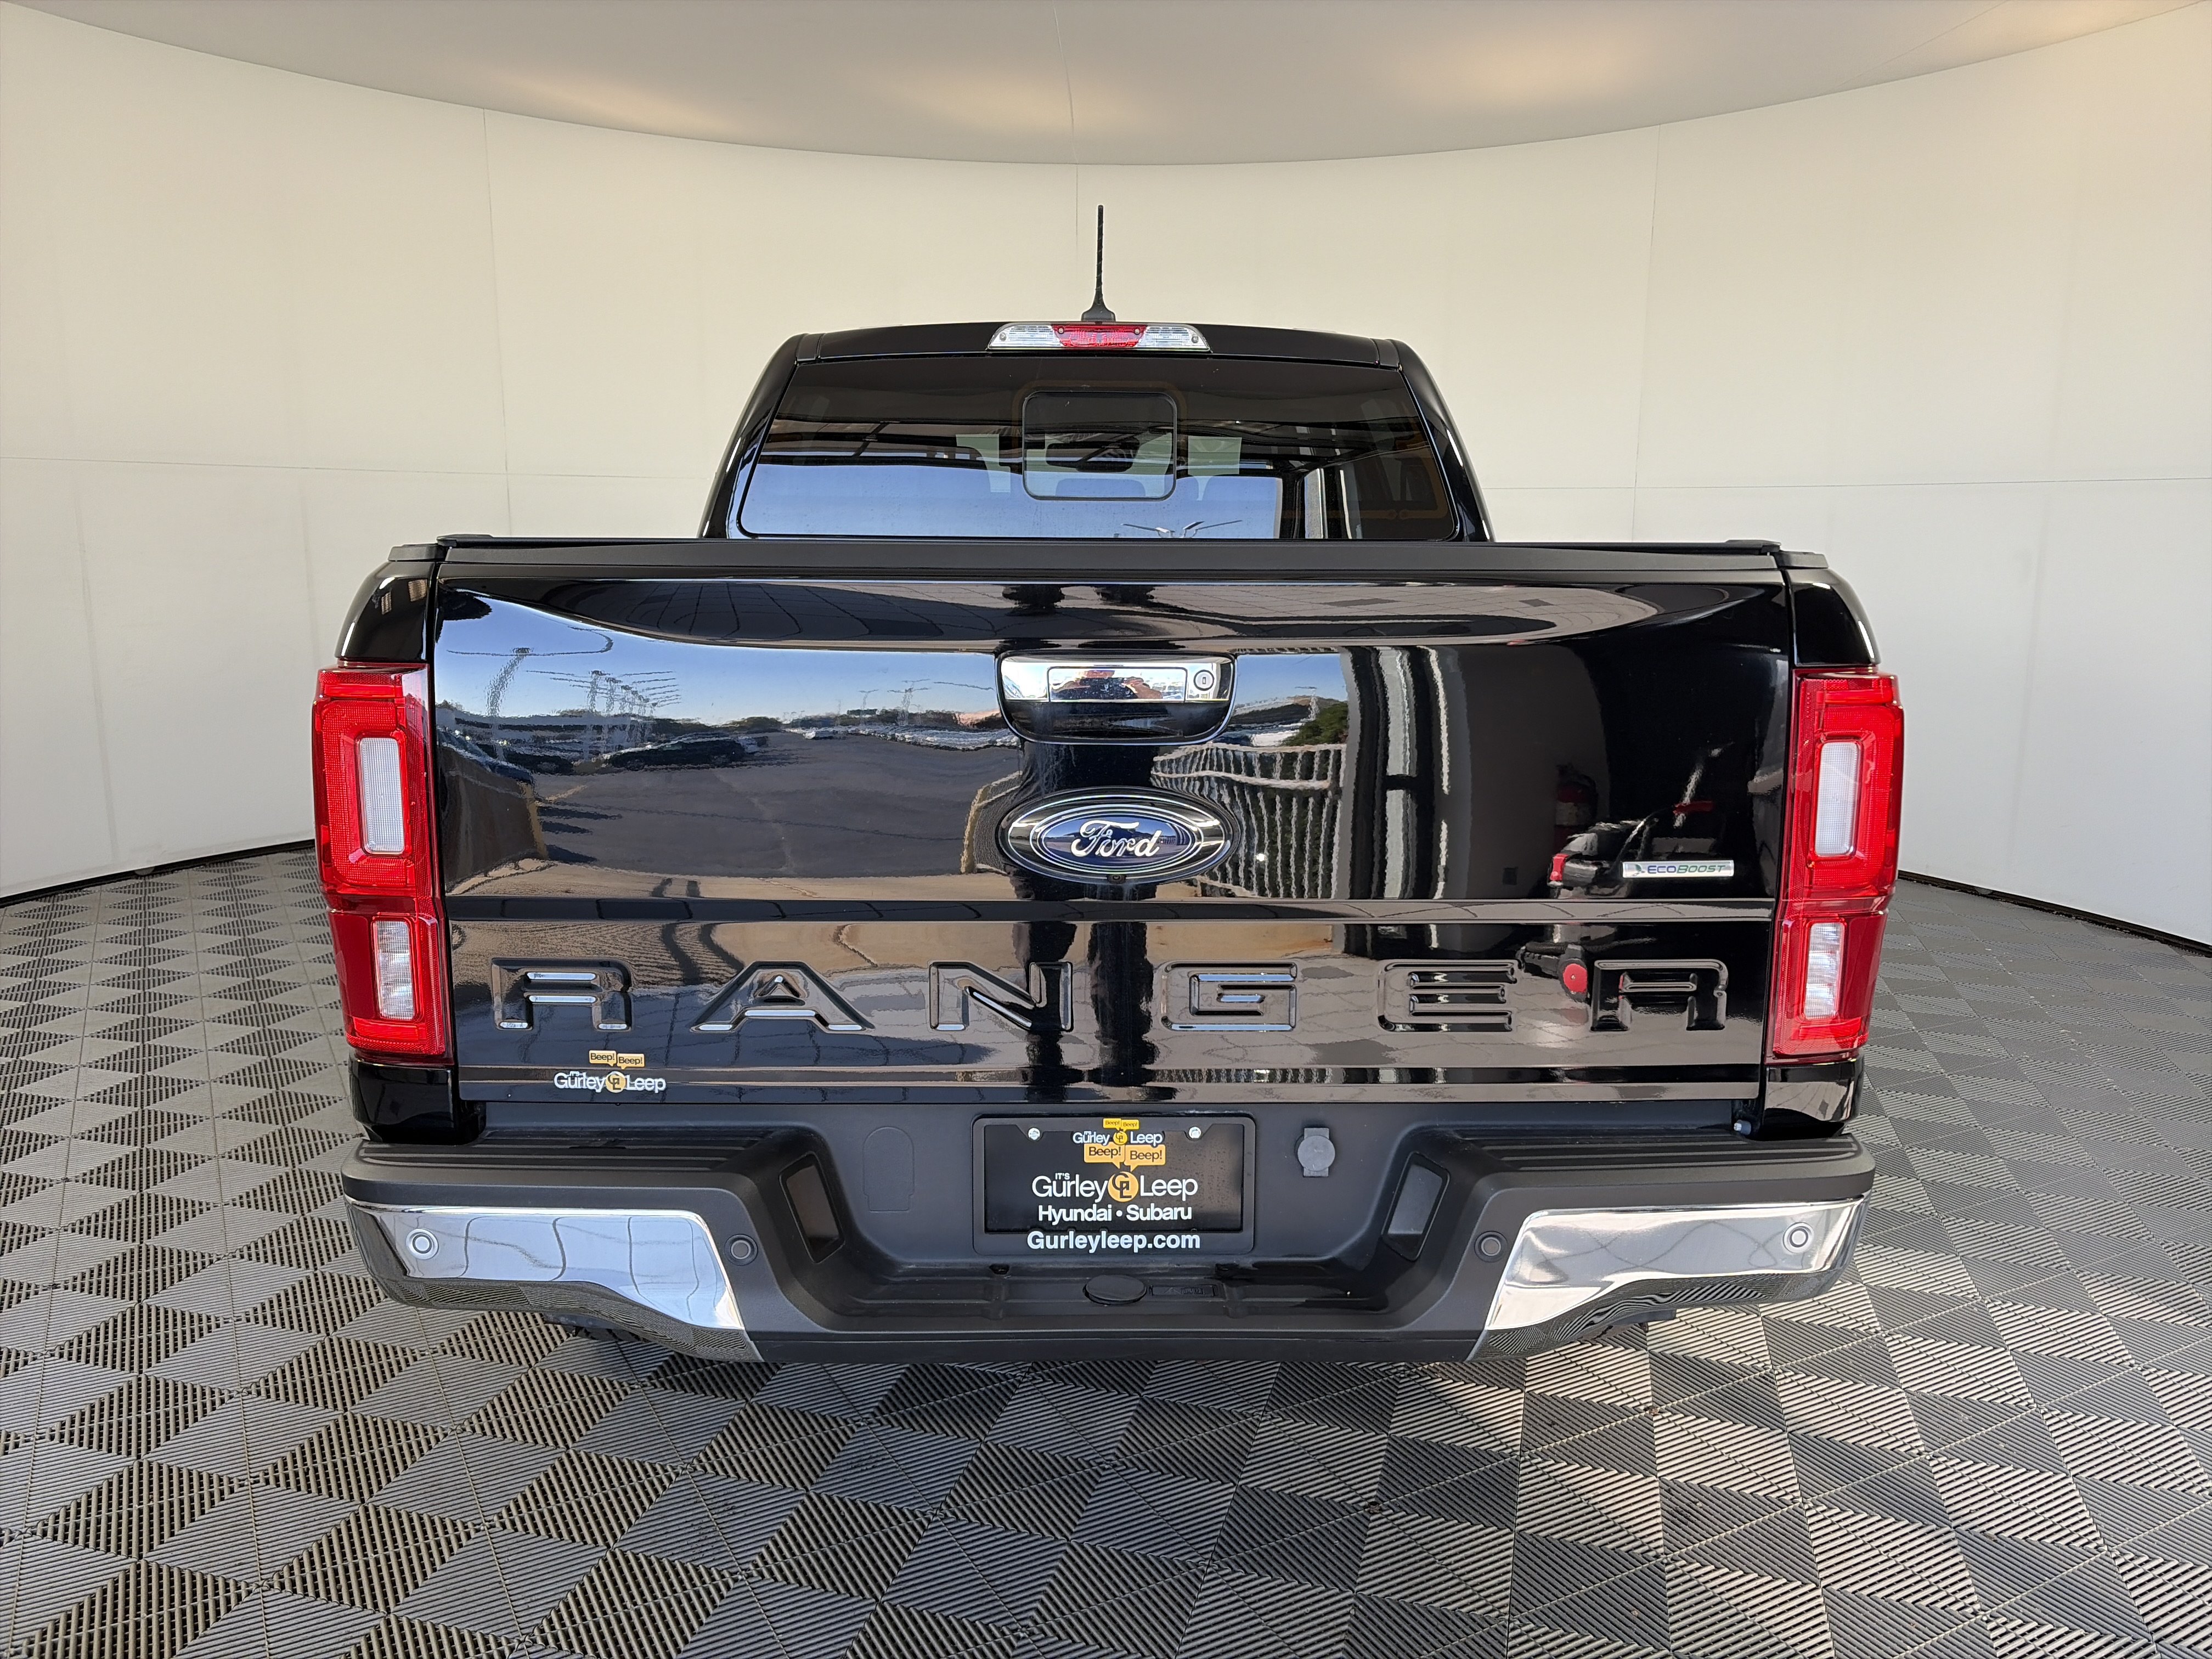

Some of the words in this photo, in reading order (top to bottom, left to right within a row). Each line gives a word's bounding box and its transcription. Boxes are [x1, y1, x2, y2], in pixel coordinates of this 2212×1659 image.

[1071, 820, 1163, 858] Ford
[1647, 865, 1726, 874] ECOBOOST
[492, 957, 1728, 1032] RANGER
[590, 1053, 615, 1062] Beep!
[618, 1057, 643, 1065] Beep!
[554, 1071, 607, 1093] Gurley
[626, 1074, 666, 1093] Leep
[1073, 1132, 1110, 1146] Gurley
[1130, 1131, 1163, 1147] Leep
[1089, 1147, 1121, 1159] Beep!
[1130, 1150, 1163, 1162] Beep!
[1032, 1174, 1108, 1203] Gurley
[1140, 1175, 1198, 1201] Leep
[1038, 1204, 1112, 1226] Hyundai
[1126, 1203, 1192, 1221] Subaru
[1027, 1230, 1200, 1254] Gurleyleep.com
